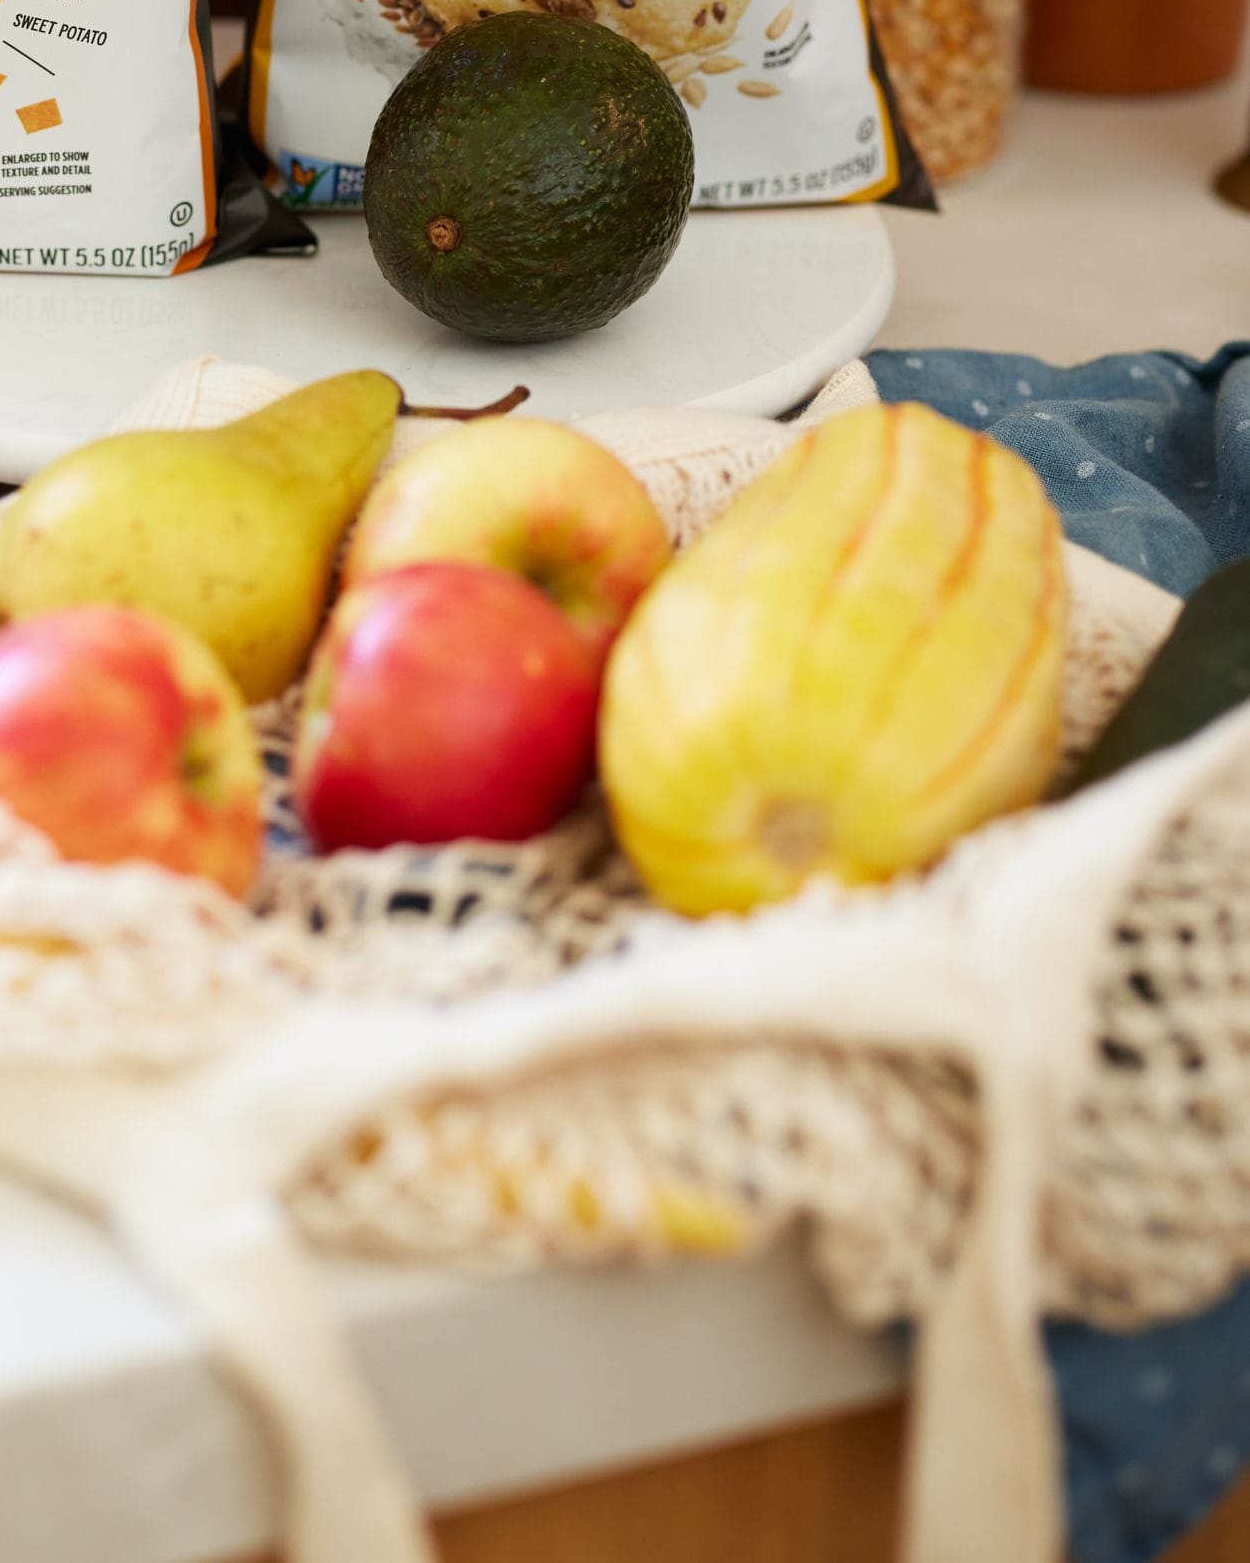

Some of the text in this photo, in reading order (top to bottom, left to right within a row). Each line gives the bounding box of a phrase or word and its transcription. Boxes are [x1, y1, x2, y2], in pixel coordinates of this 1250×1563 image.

[12, 12, 108, 47] SWEET POTATO
[1, 151, 90, 166] ENLARGED TO SHOW
[1, 164, 92, 178] TEXTURE AND DETAIL
[37, 184, 92, 196] SUGGESTION
[39, 247, 70, 267] WT
[75, 247, 106, 268] 5.5
[111, 247, 136, 268] OZ
